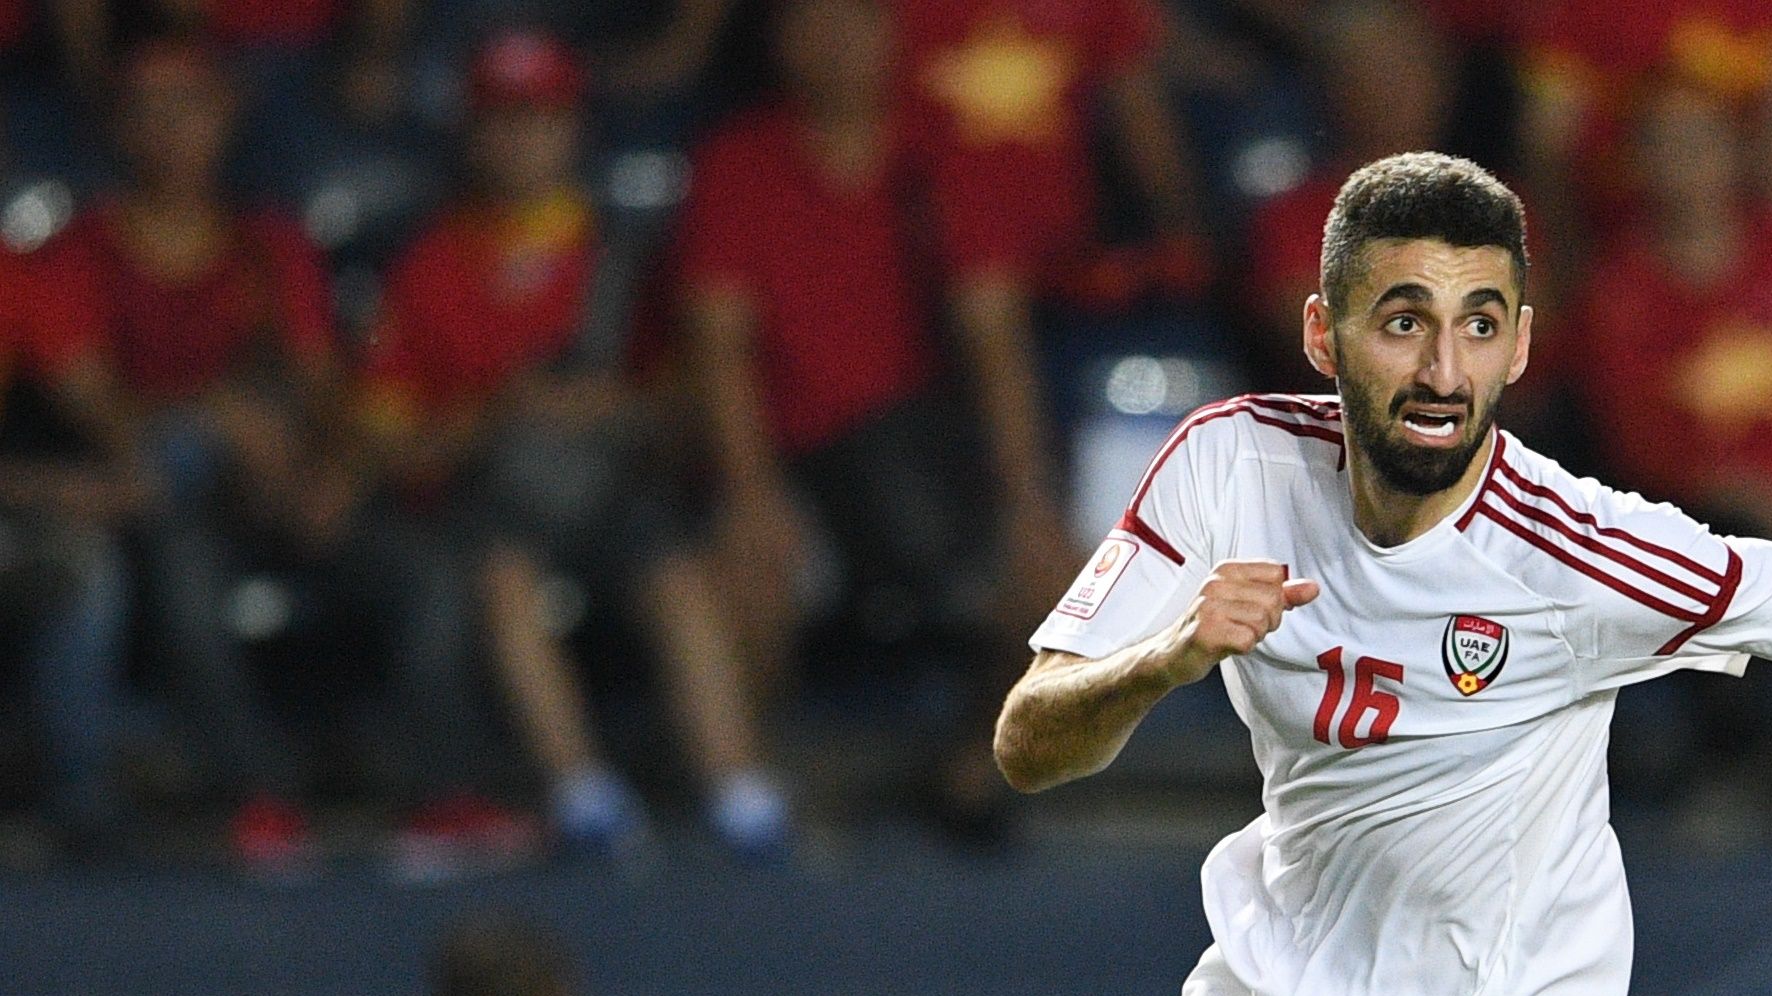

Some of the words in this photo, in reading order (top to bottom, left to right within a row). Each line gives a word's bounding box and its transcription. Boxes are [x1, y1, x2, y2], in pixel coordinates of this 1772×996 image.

[1459, 637, 1491, 653] UAE
[1464, 650, 1480, 662] FA
[1313, 646, 1404, 749] 16
